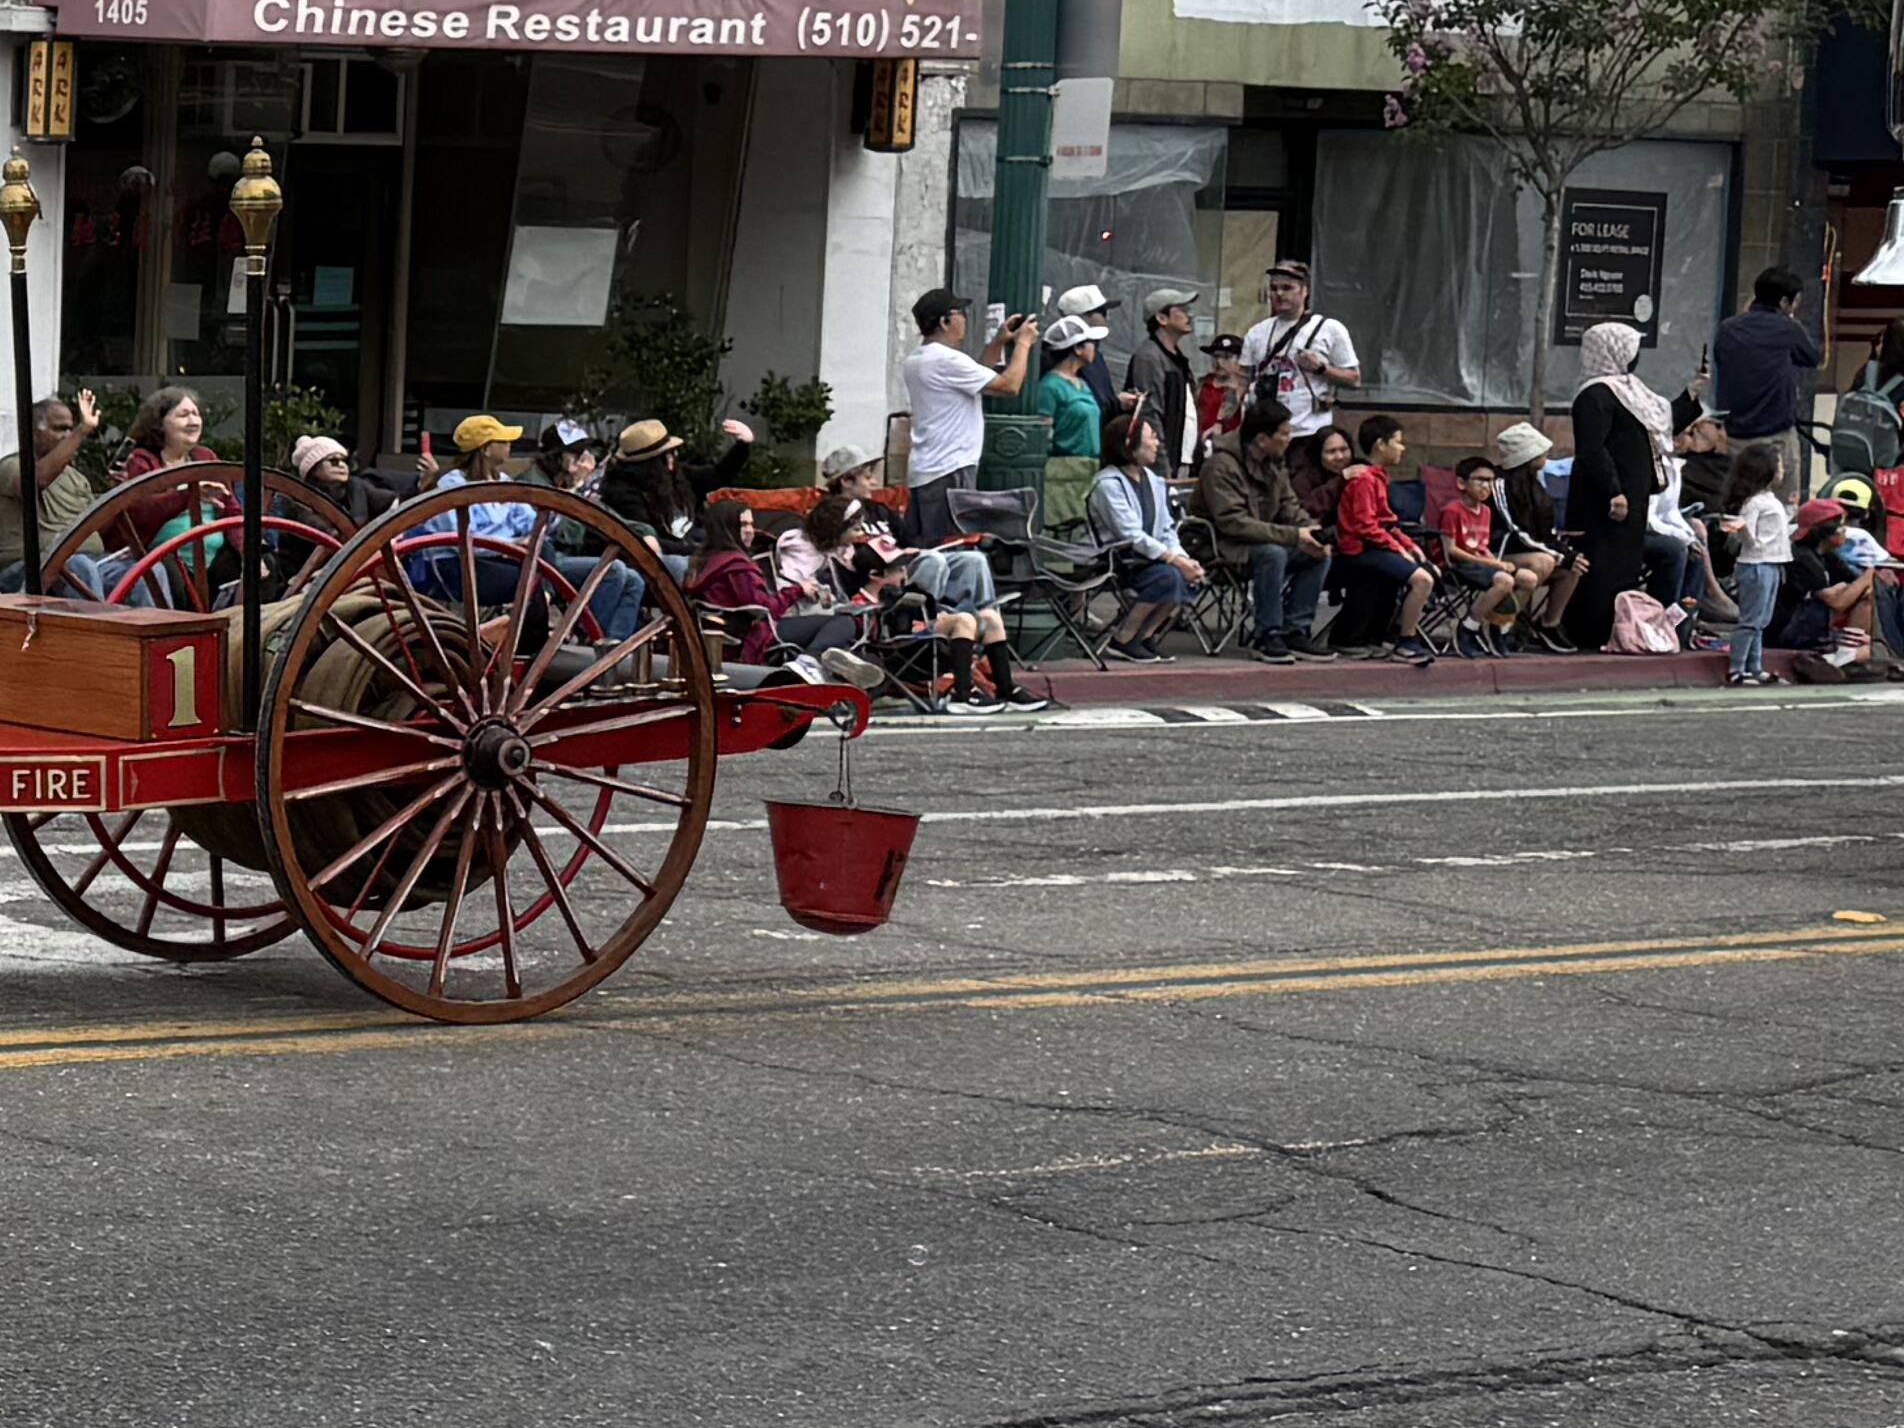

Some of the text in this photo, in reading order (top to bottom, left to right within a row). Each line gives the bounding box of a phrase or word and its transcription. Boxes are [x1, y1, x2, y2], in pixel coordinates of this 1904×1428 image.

[486, 3, 766, 46] Restaurant
[797, 6, 890, 53] (510)
[54, 50, 69, 124] ARK
[1572, 222, 1630, 239] FOR LEASE
[166, 645, 203, 728] 1
[11, 768, 92, 801] FIRE
